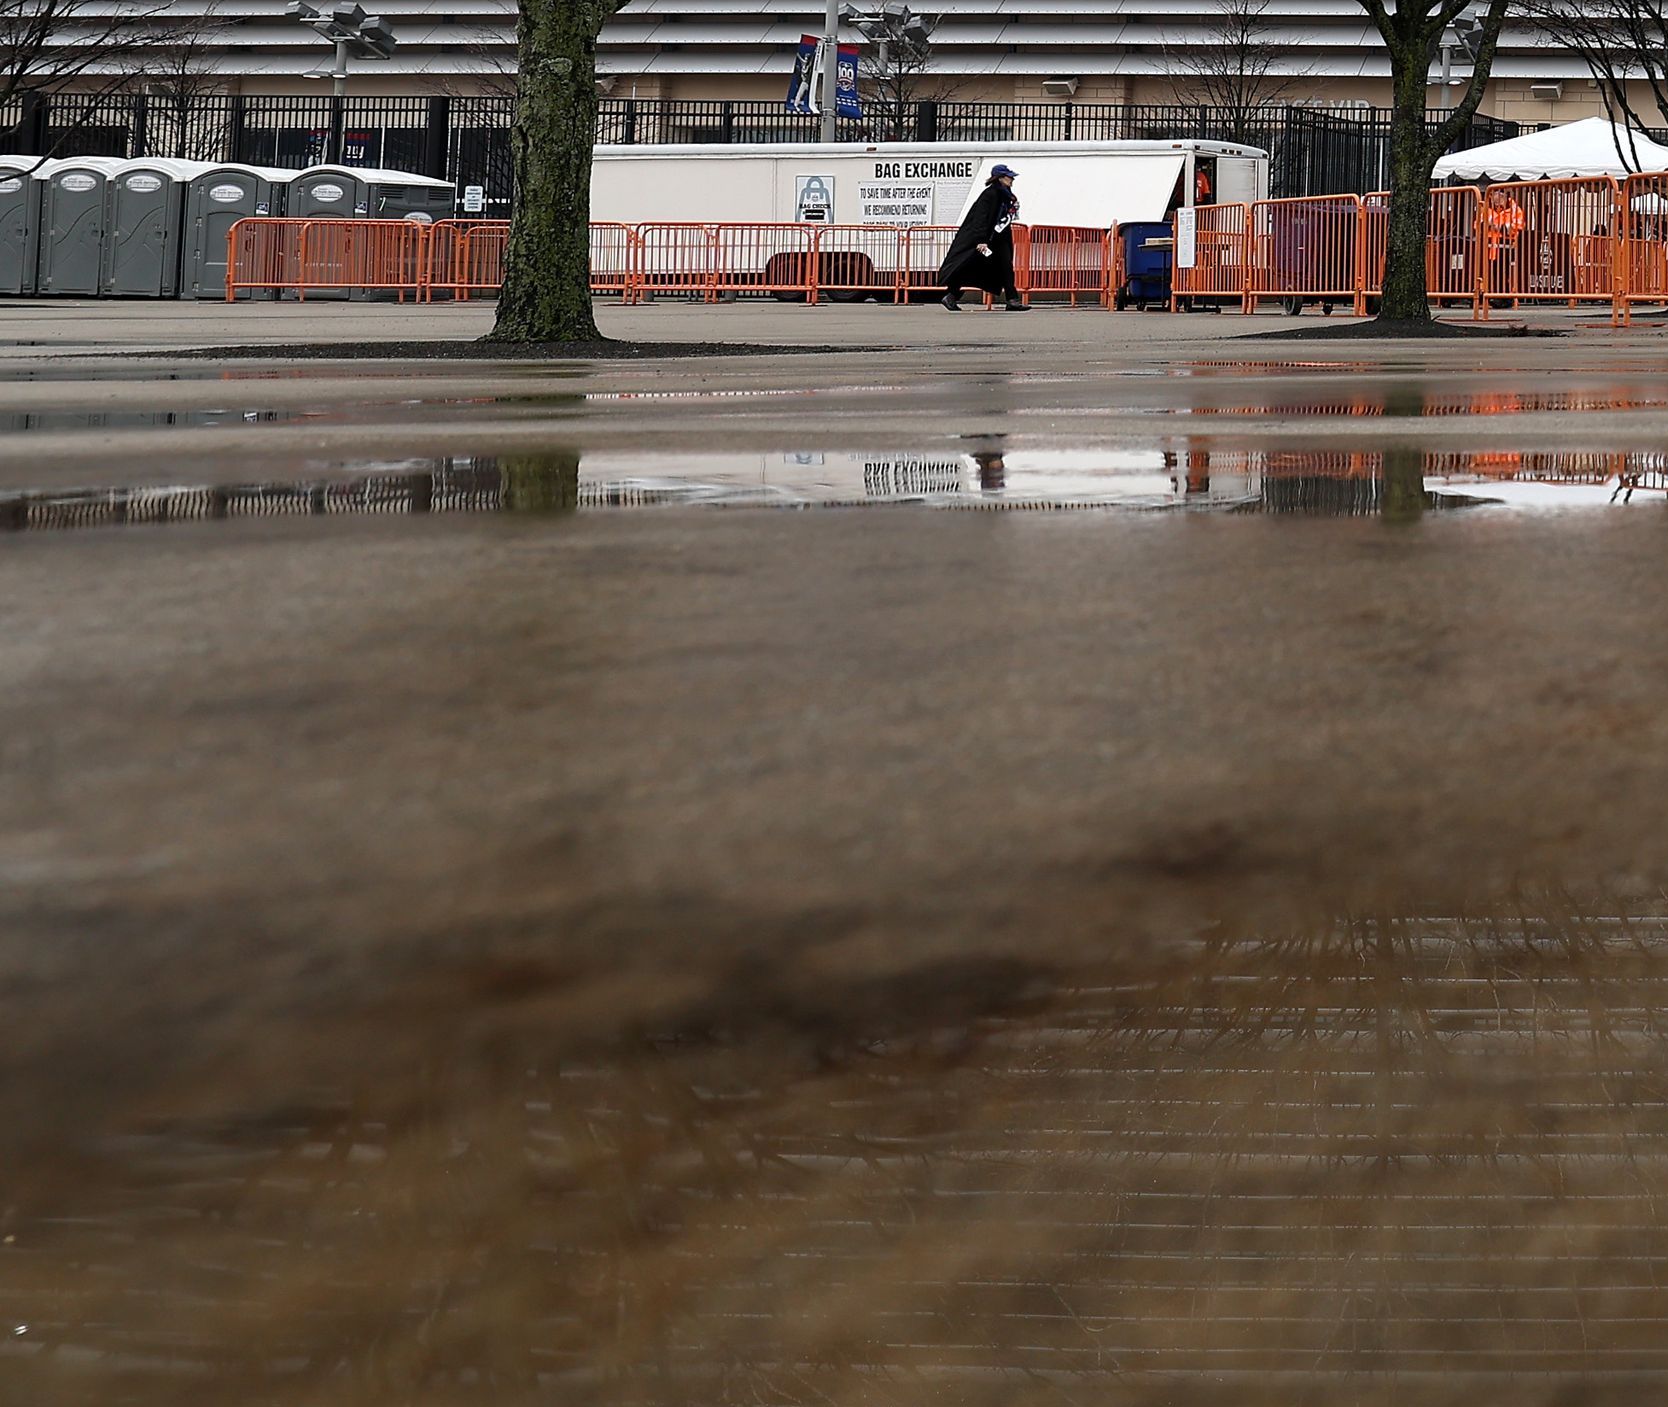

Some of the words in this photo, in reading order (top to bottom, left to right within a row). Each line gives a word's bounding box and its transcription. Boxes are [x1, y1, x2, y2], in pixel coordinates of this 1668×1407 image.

[875, 162, 901, 178] BAG
[904, 162, 973, 178] EXCHANGE
[860, 187, 867, 199] TO
[867, 187, 880, 199] SAVE
[880, 187, 892, 199] TIME
[892, 187, 907, 199] AFTER
[864, 204, 871, 216] WE
[871, 203, 901, 216] RECOMMEND
[901, 203, 928, 216] RETURNING
